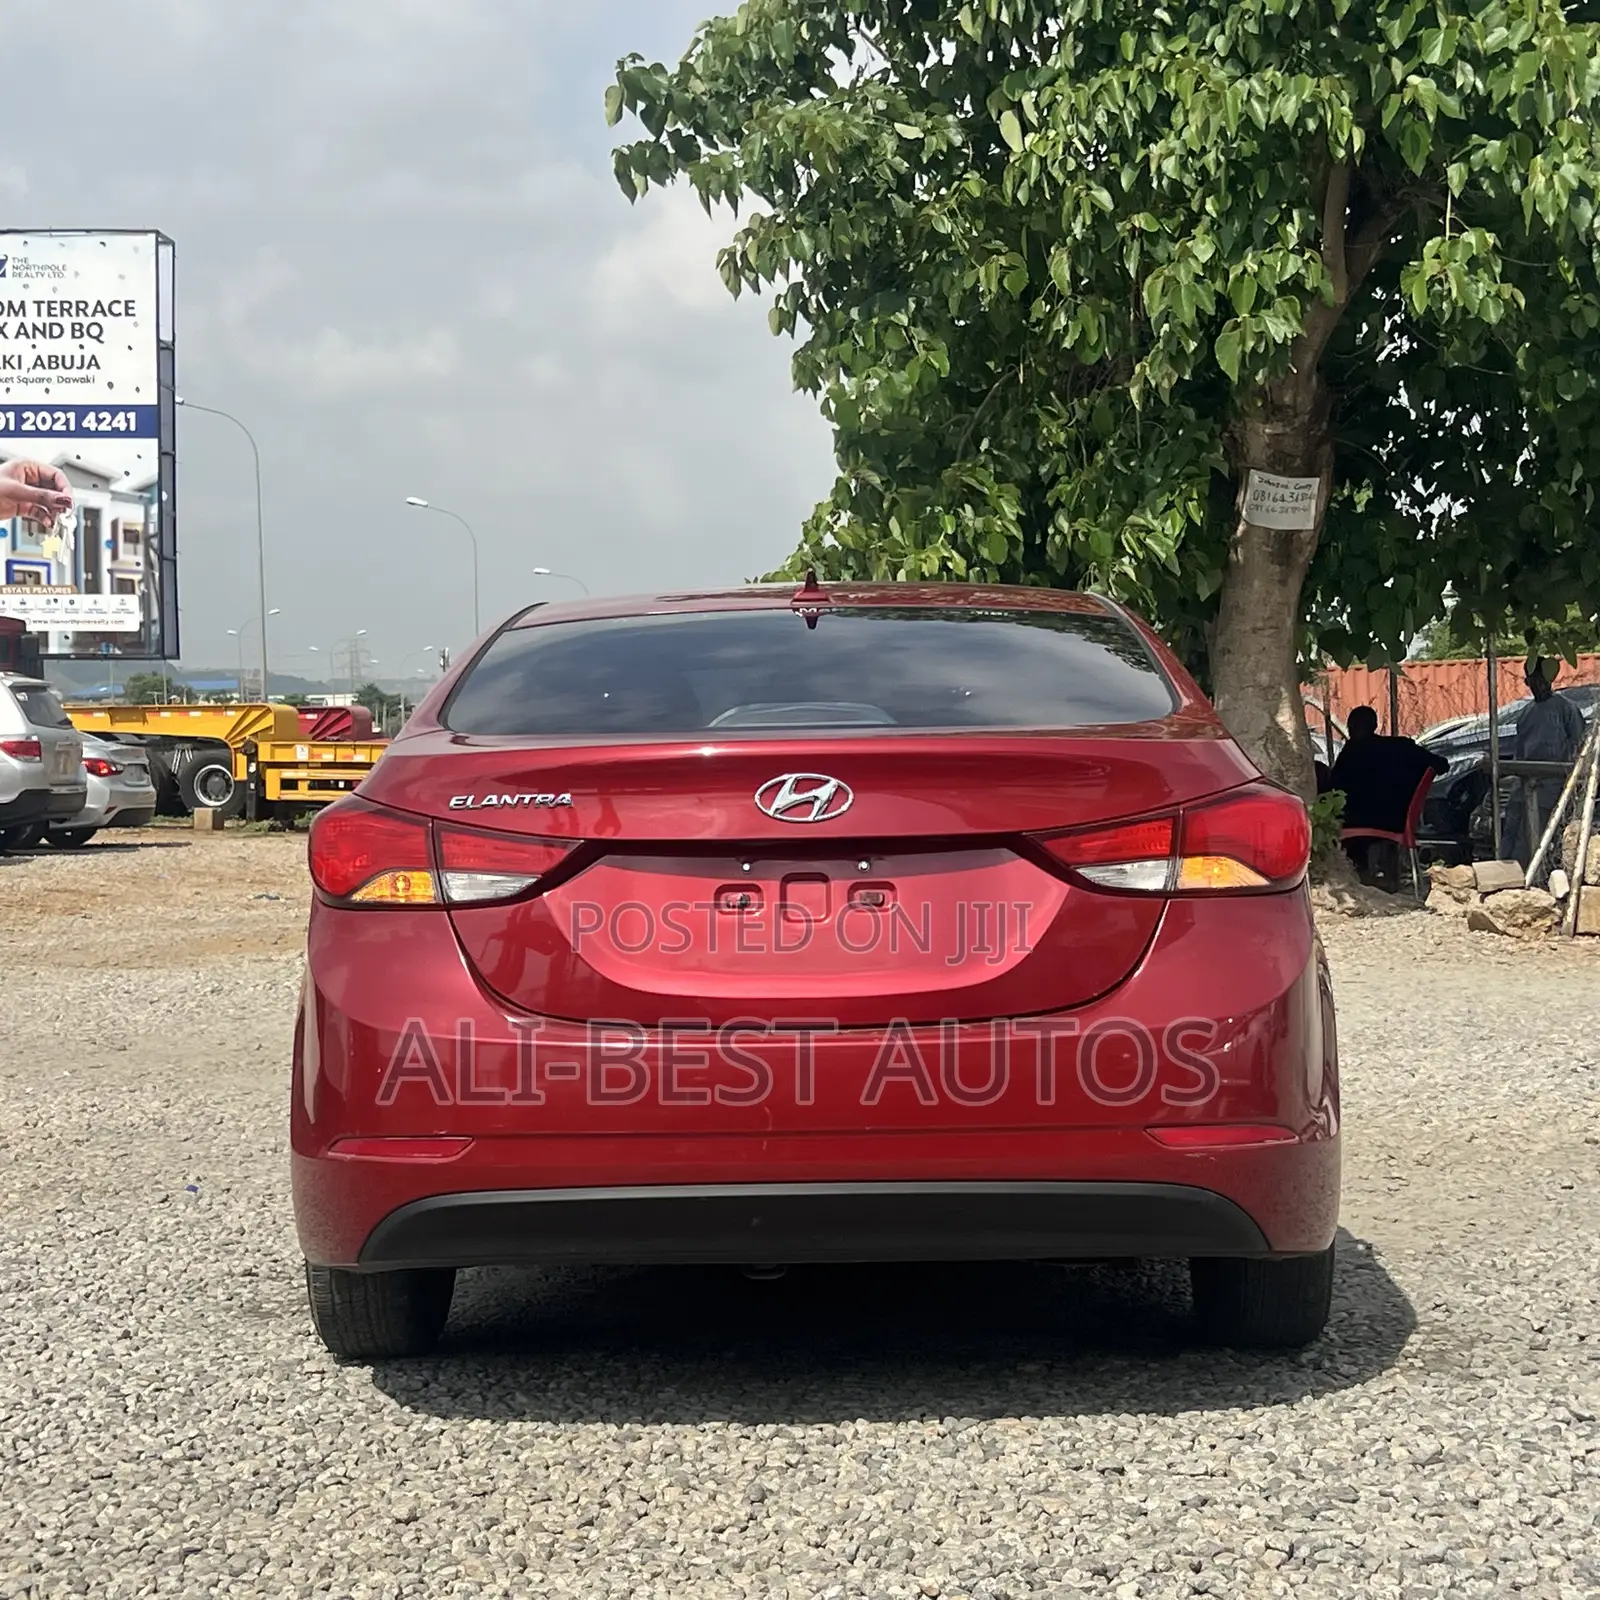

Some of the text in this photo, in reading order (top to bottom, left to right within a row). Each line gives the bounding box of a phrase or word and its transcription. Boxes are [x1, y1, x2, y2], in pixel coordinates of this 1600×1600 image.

[11, 256, 29, 264] THE
[12, 271, 46, 279] REALTY
[32, 299, 137, 318] TERRACE
[14, 321, 65, 340] AND
[71, 321, 105, 344] BQ
[57, 374, 95, 384] Dawaki
[21, 410, 76, 432] 2021
[81, 410, 137, 432] 4241
[2, 586, 72, 595] ESTATE FEATURES
[449, 792, 574, 809] ELANTRA
